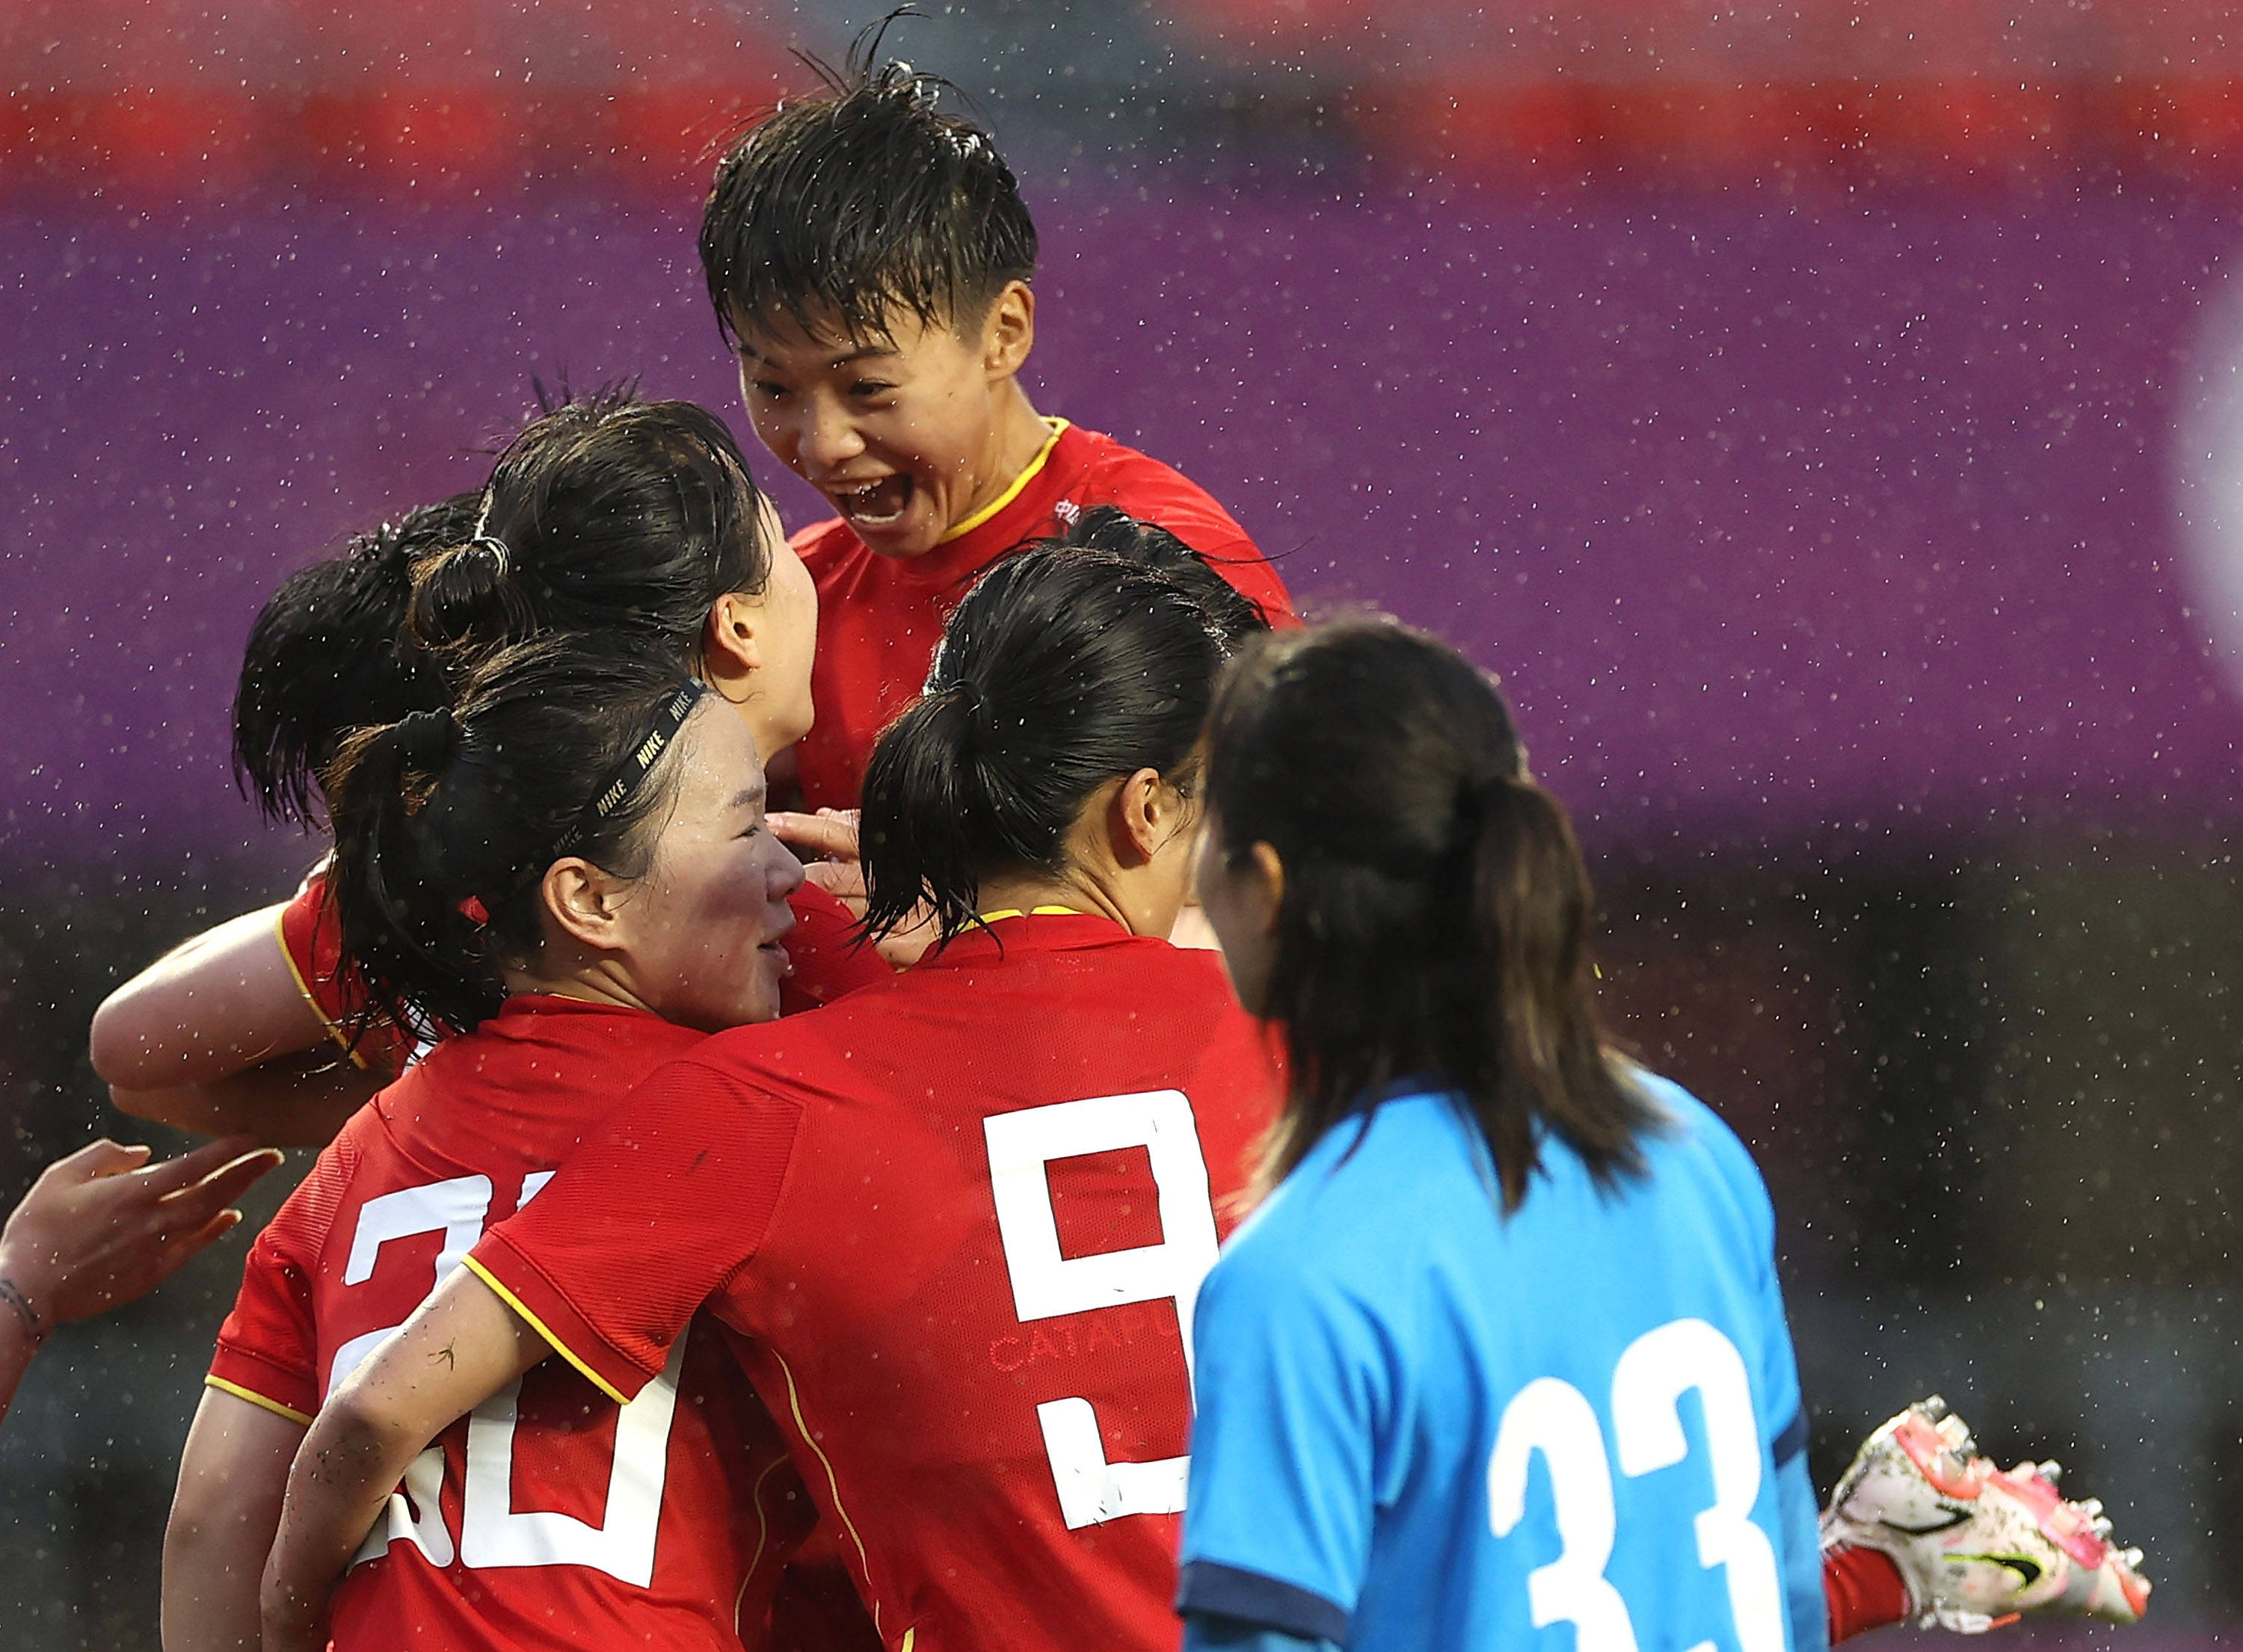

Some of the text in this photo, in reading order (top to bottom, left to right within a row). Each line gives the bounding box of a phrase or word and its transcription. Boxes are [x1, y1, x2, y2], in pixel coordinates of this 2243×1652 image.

[669, 690, 692, 721] NIKE
[636, 730, 665, 769] NIKE
[596, 778, 627, 817] NIKE
[983, 1088, 1221, 1530] 9
[1487, 1317, 1786, 1652] 33
